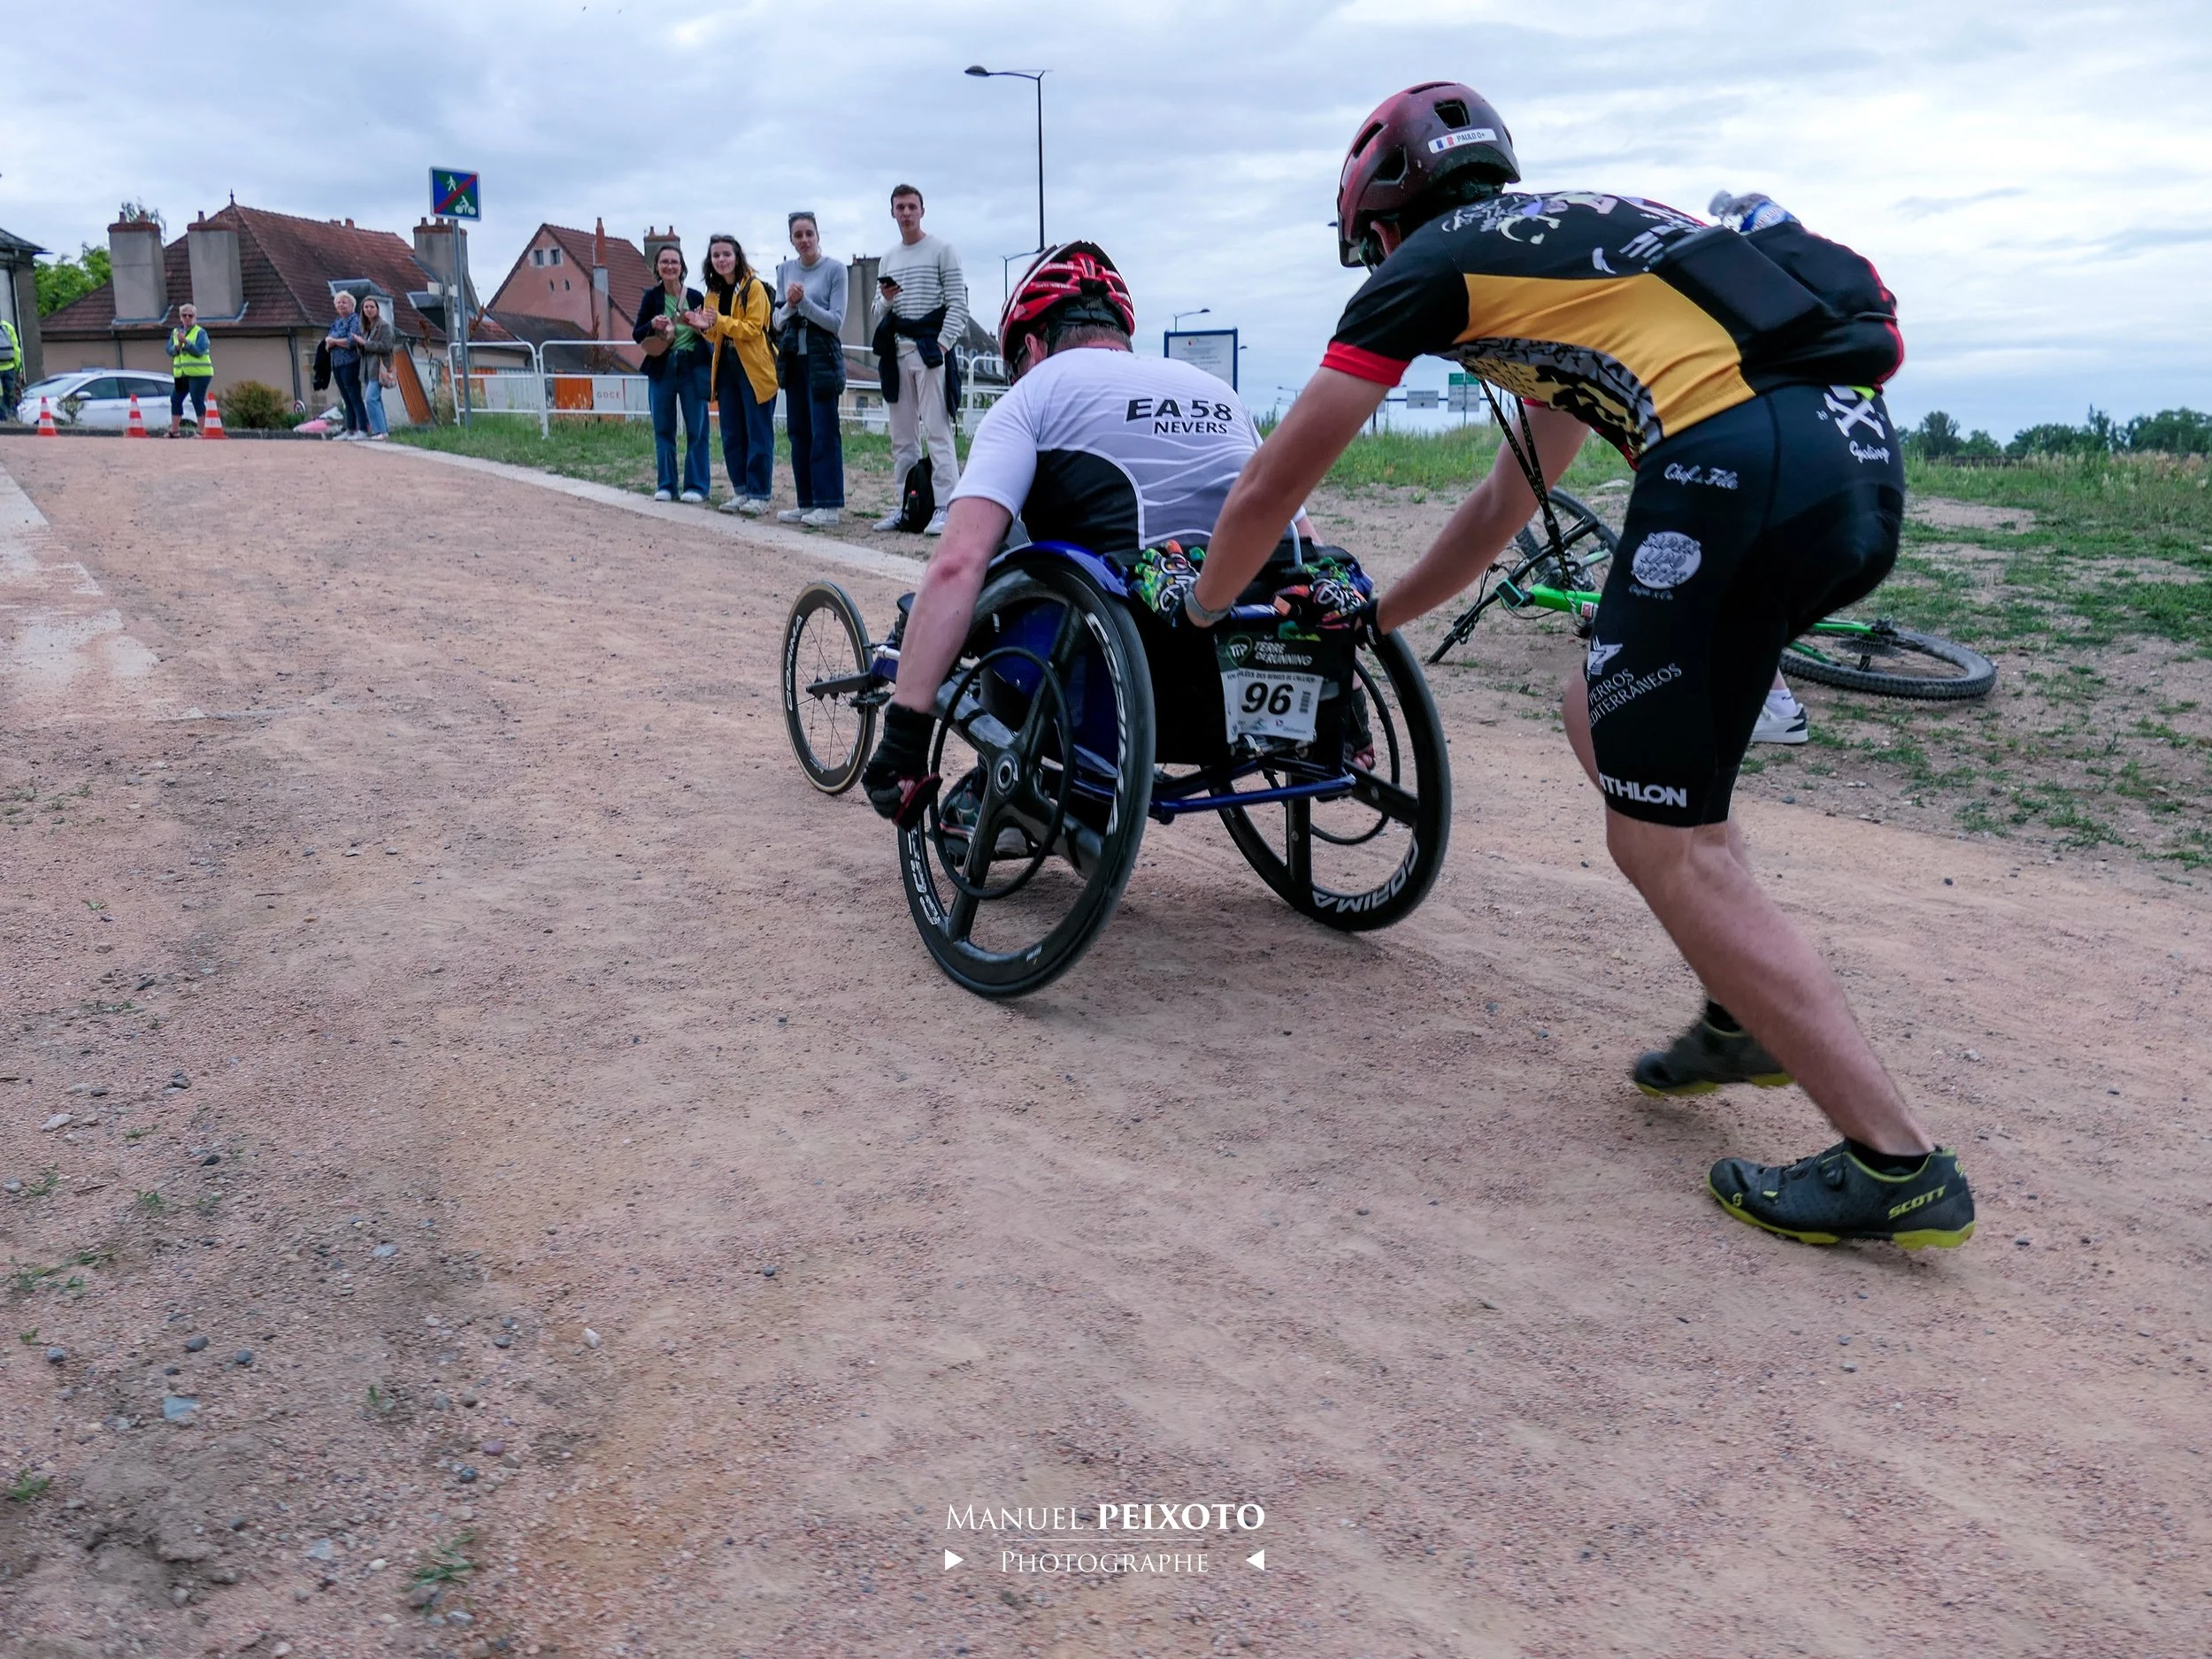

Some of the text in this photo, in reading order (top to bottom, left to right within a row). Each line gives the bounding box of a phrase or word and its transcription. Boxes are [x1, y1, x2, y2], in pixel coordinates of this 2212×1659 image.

[1125, 398, 1233, 422] EA 58
[1153, 421, 1228, 434] NEVERS
[1240, 681, 1294, 716] 96
[1589, 668, 1634, 706] PERROS
[1887, 1185, 1947, 1220] SCOTT
